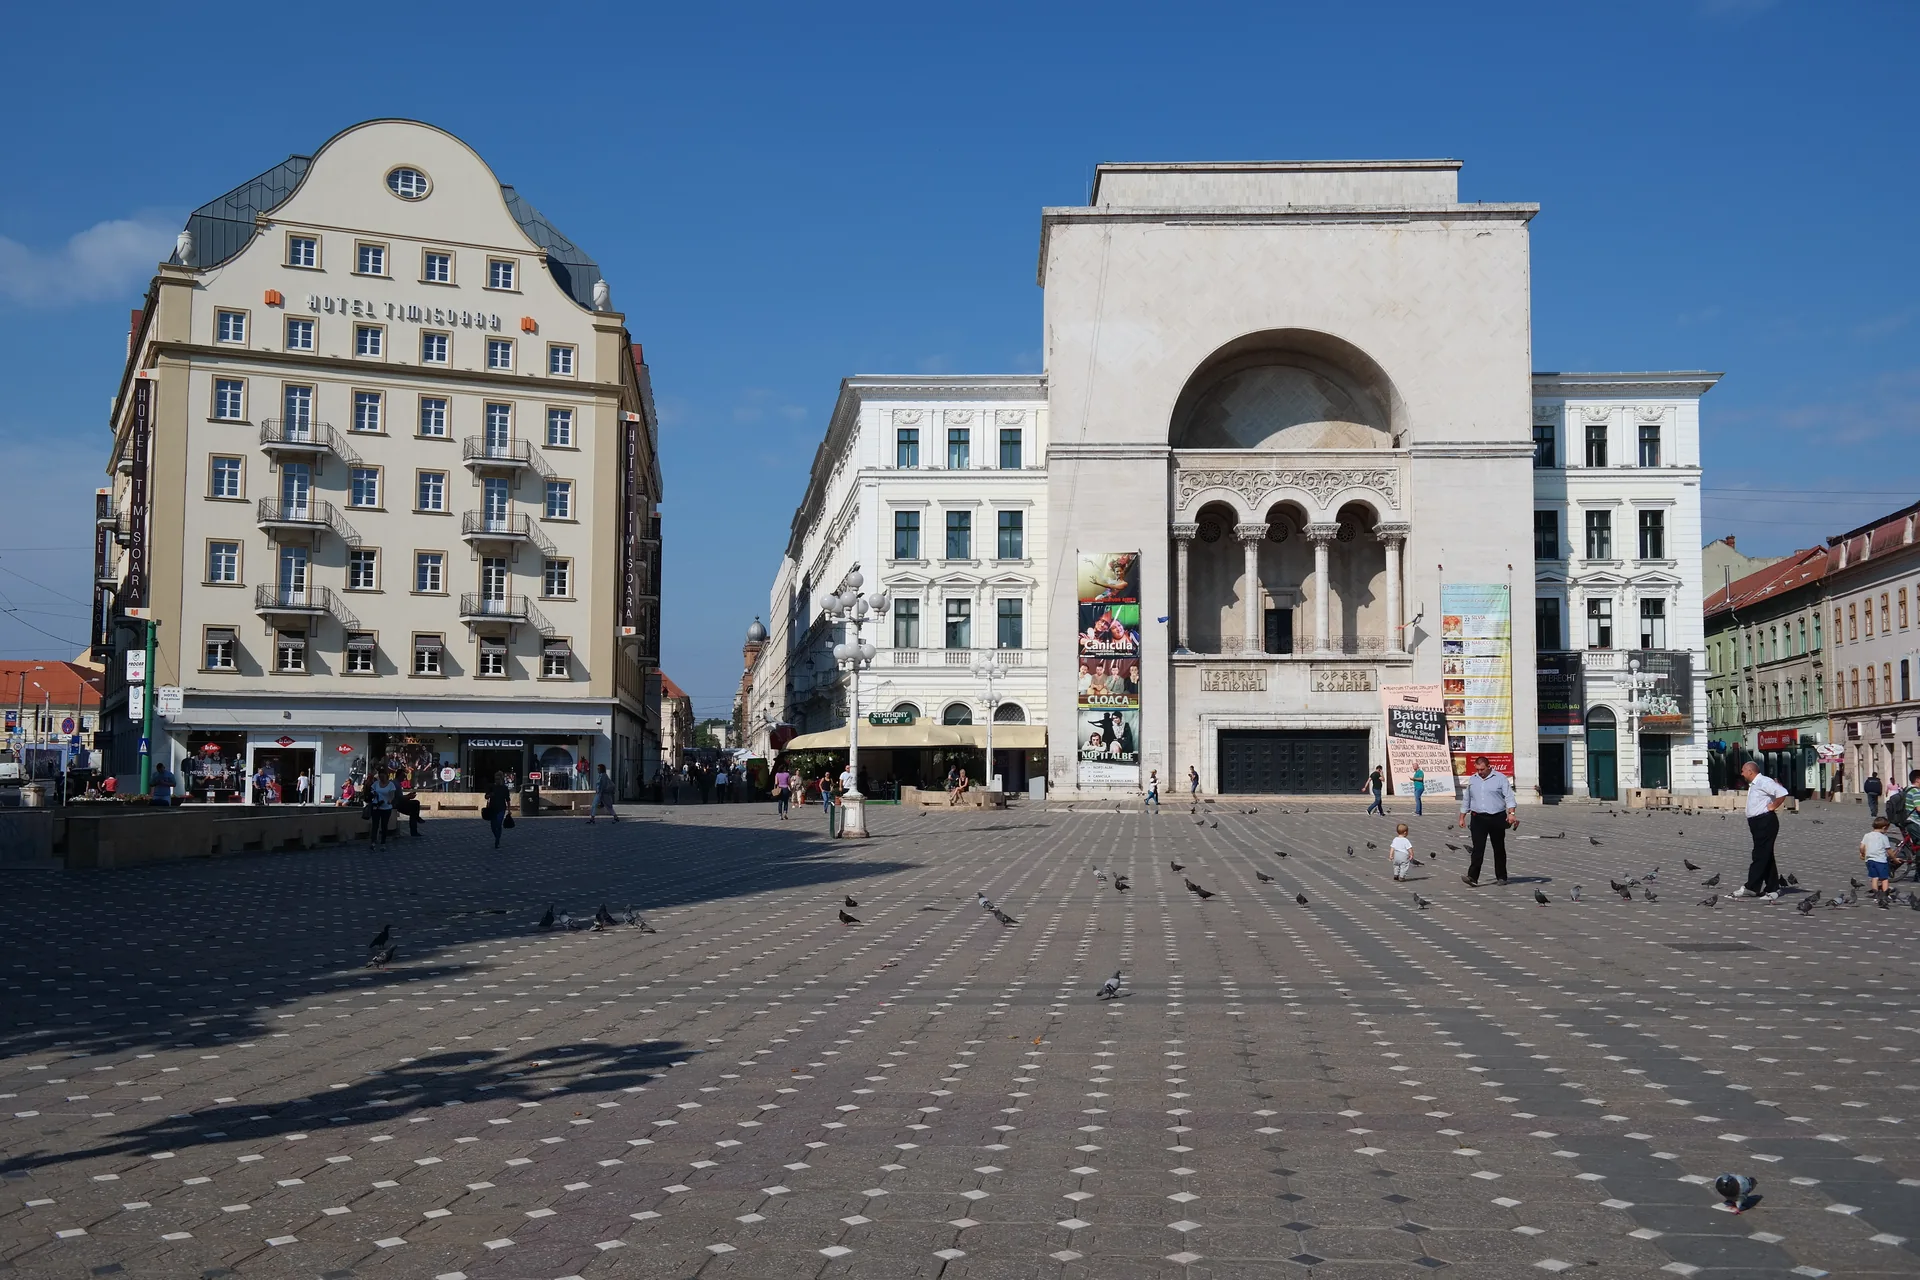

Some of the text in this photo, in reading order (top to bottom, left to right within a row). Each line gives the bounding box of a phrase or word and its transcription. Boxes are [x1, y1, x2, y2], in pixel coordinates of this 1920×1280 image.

[308, 294, 374, 315] HOTEL
[136, 389, 147, 463] HOTEL
[628, 430, 636, 497] HOTEL
[1084, 640, 1133, 650] Canicula
[1087, 695, 1130, 705] CLOACA
[1396, 720, 1441, 731] de aur
[1110, 752, 1134, 760] ALBE
